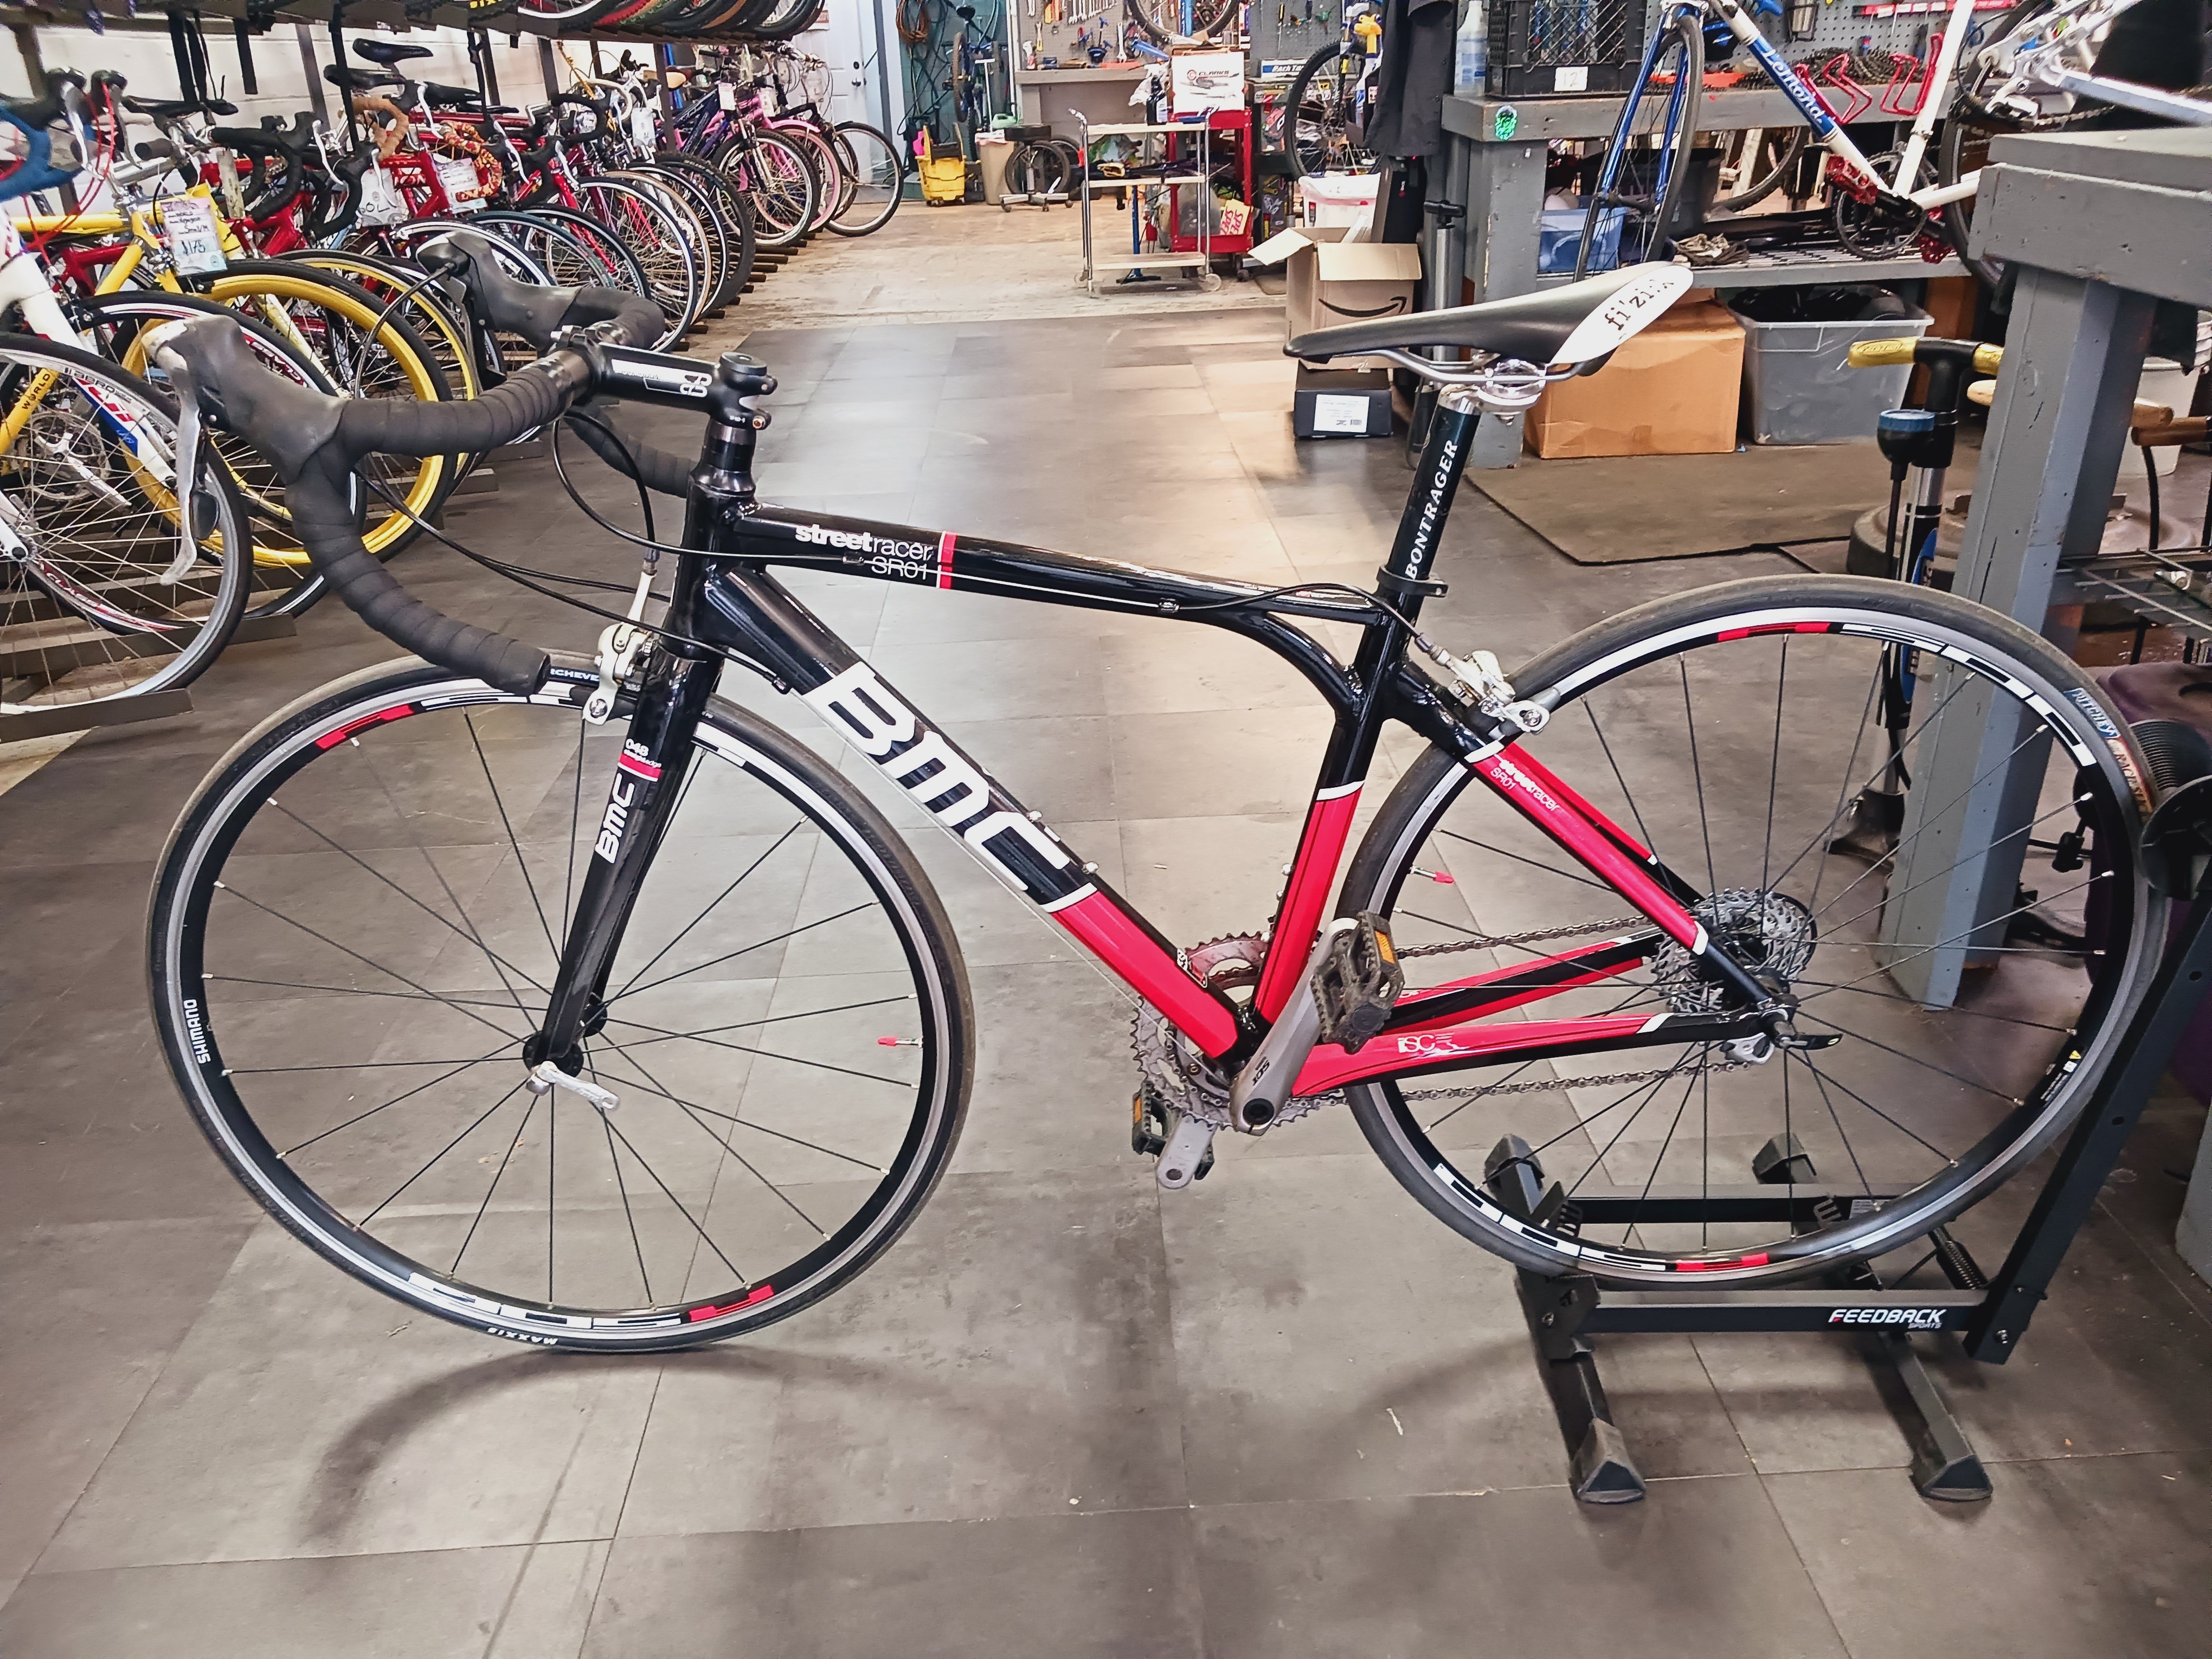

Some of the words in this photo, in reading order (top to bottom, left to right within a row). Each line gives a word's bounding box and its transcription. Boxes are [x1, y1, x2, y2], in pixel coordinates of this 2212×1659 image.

[22, 373, 51, 410] WORLD
[1405, 440, 1458, 580] BONTRAGER
[625, 738, 649, 757] 048
[801, 661, 1071, 891] BMC
[1490, 767, 1517, 790] SR01
[595, 773, 635, 864] BMC
[183, 999, 211, 1064] SHIMANO
[1828, 1309, 1947, 1323] FEEDBACK
[487, 1327, 558, 1345] MAXXIS
